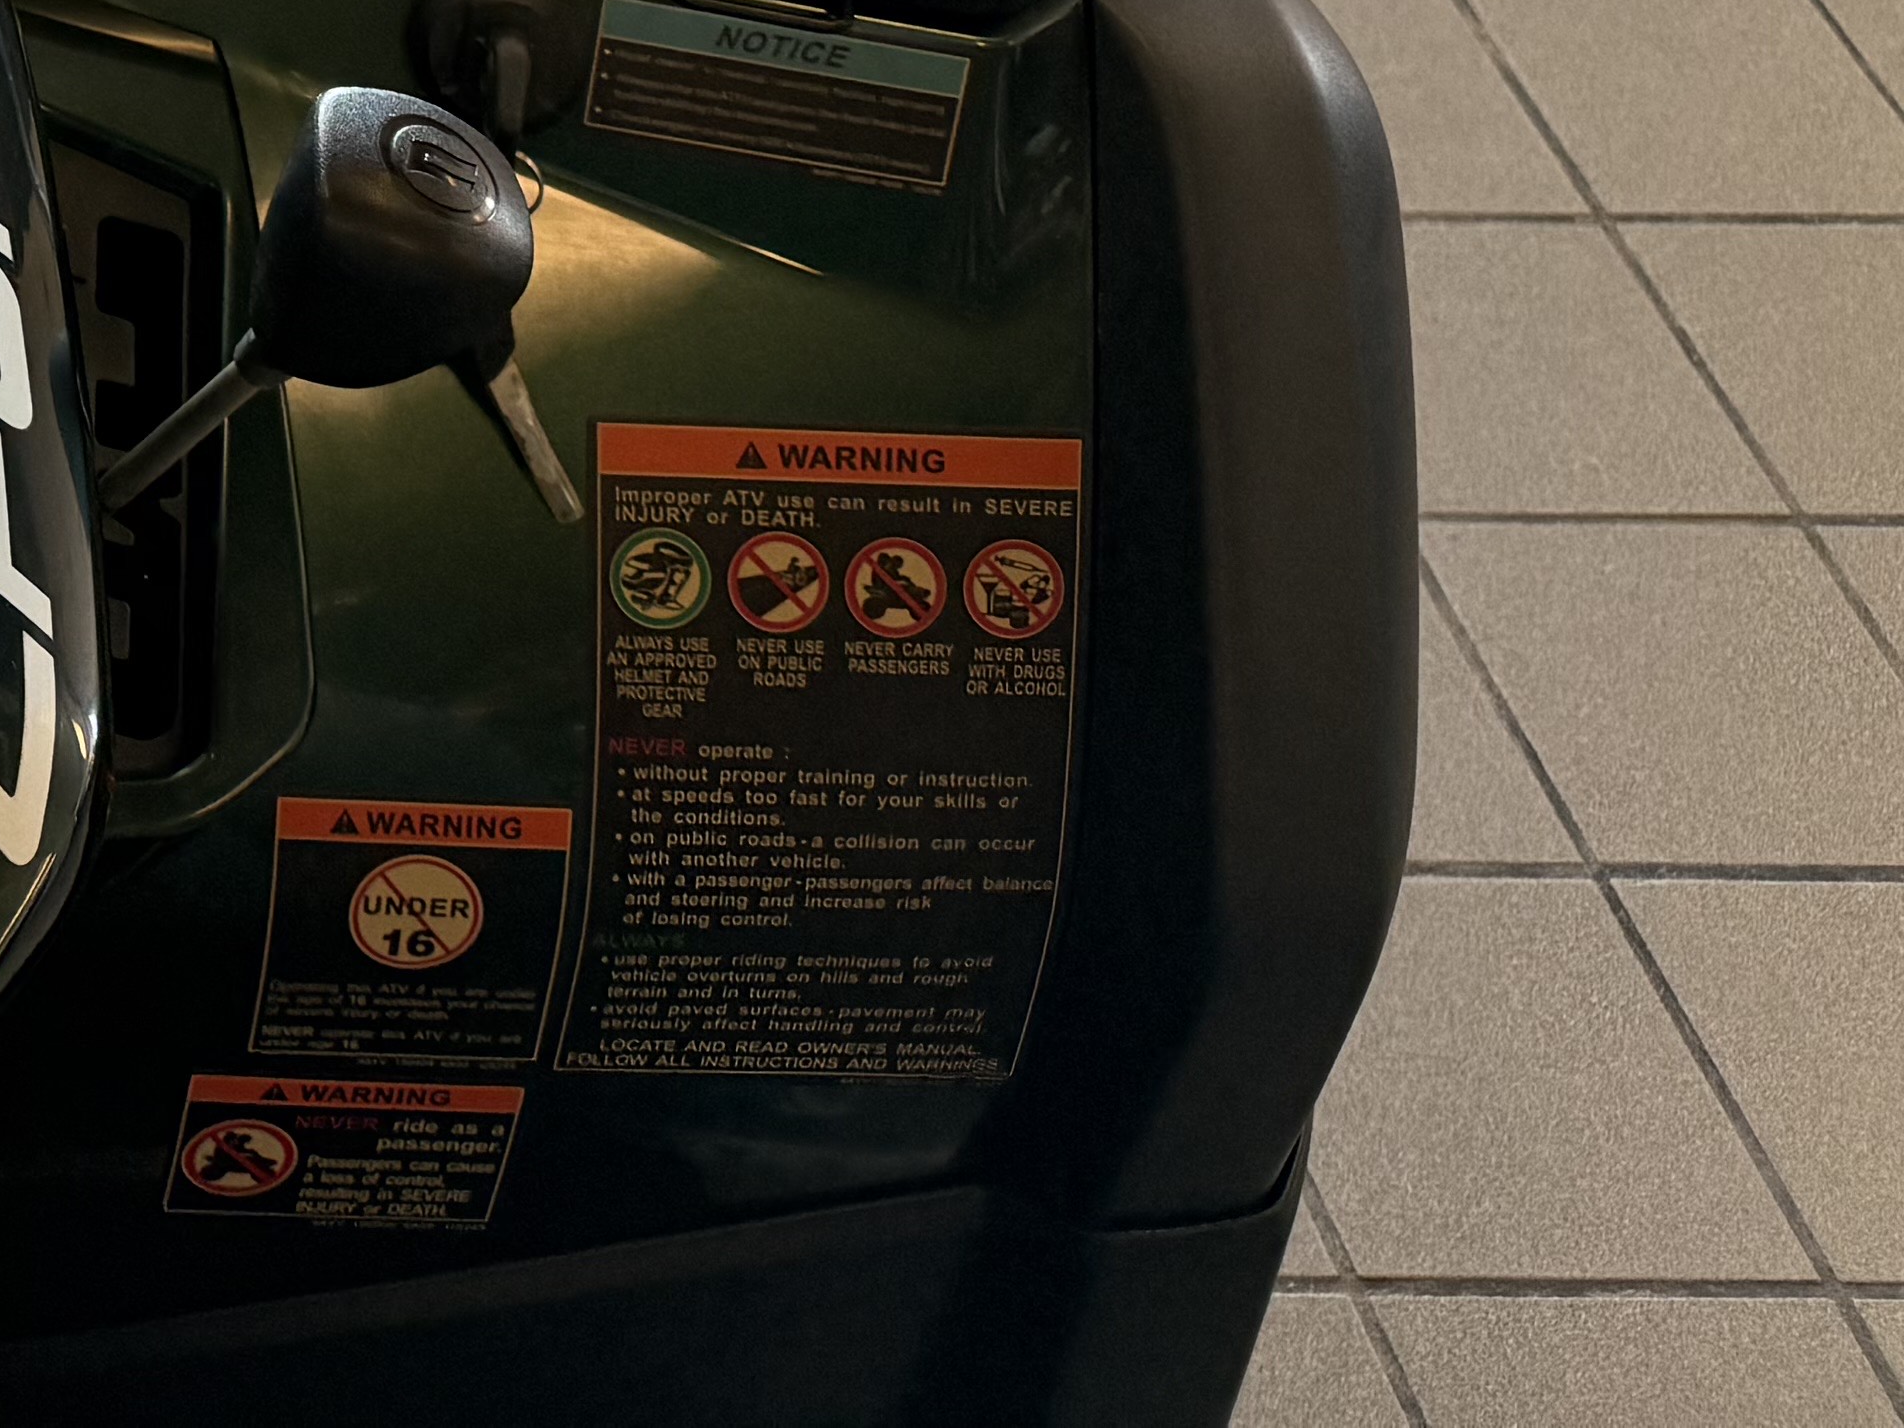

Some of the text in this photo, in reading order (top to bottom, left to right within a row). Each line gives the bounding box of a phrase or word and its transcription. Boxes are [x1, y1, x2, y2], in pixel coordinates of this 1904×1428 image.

[715, 25, 851, 68] NOTICE
[778, 444, 946, 474] WARNING
[615, 486, 1073, 517] Improper ATV use can result in SEVERE
[615, 502, 820, 528] INJURY or DEATH.
[736, 637, 825, 655] NEVER USE
[844, 641, 954, 658] NEVER CARRY
[737, 654, 822, 671] ON PUBLIC
[848, 658, 950, 675] PASSENGERS
[753, 671, 807, 688] ROADS
[633, 764, 1033, 789] without proper training or instruction.
[367, 811, 522, 841] WARNING
[363, 896, 470, 919] UNDER
[383, 929, 435, 957] 16
[301, 1085, 451, 1107] WARNING
[295, 1114, 505, 1137] NEVER ride as a
[376, 1138, 503, 1156] passenger.
